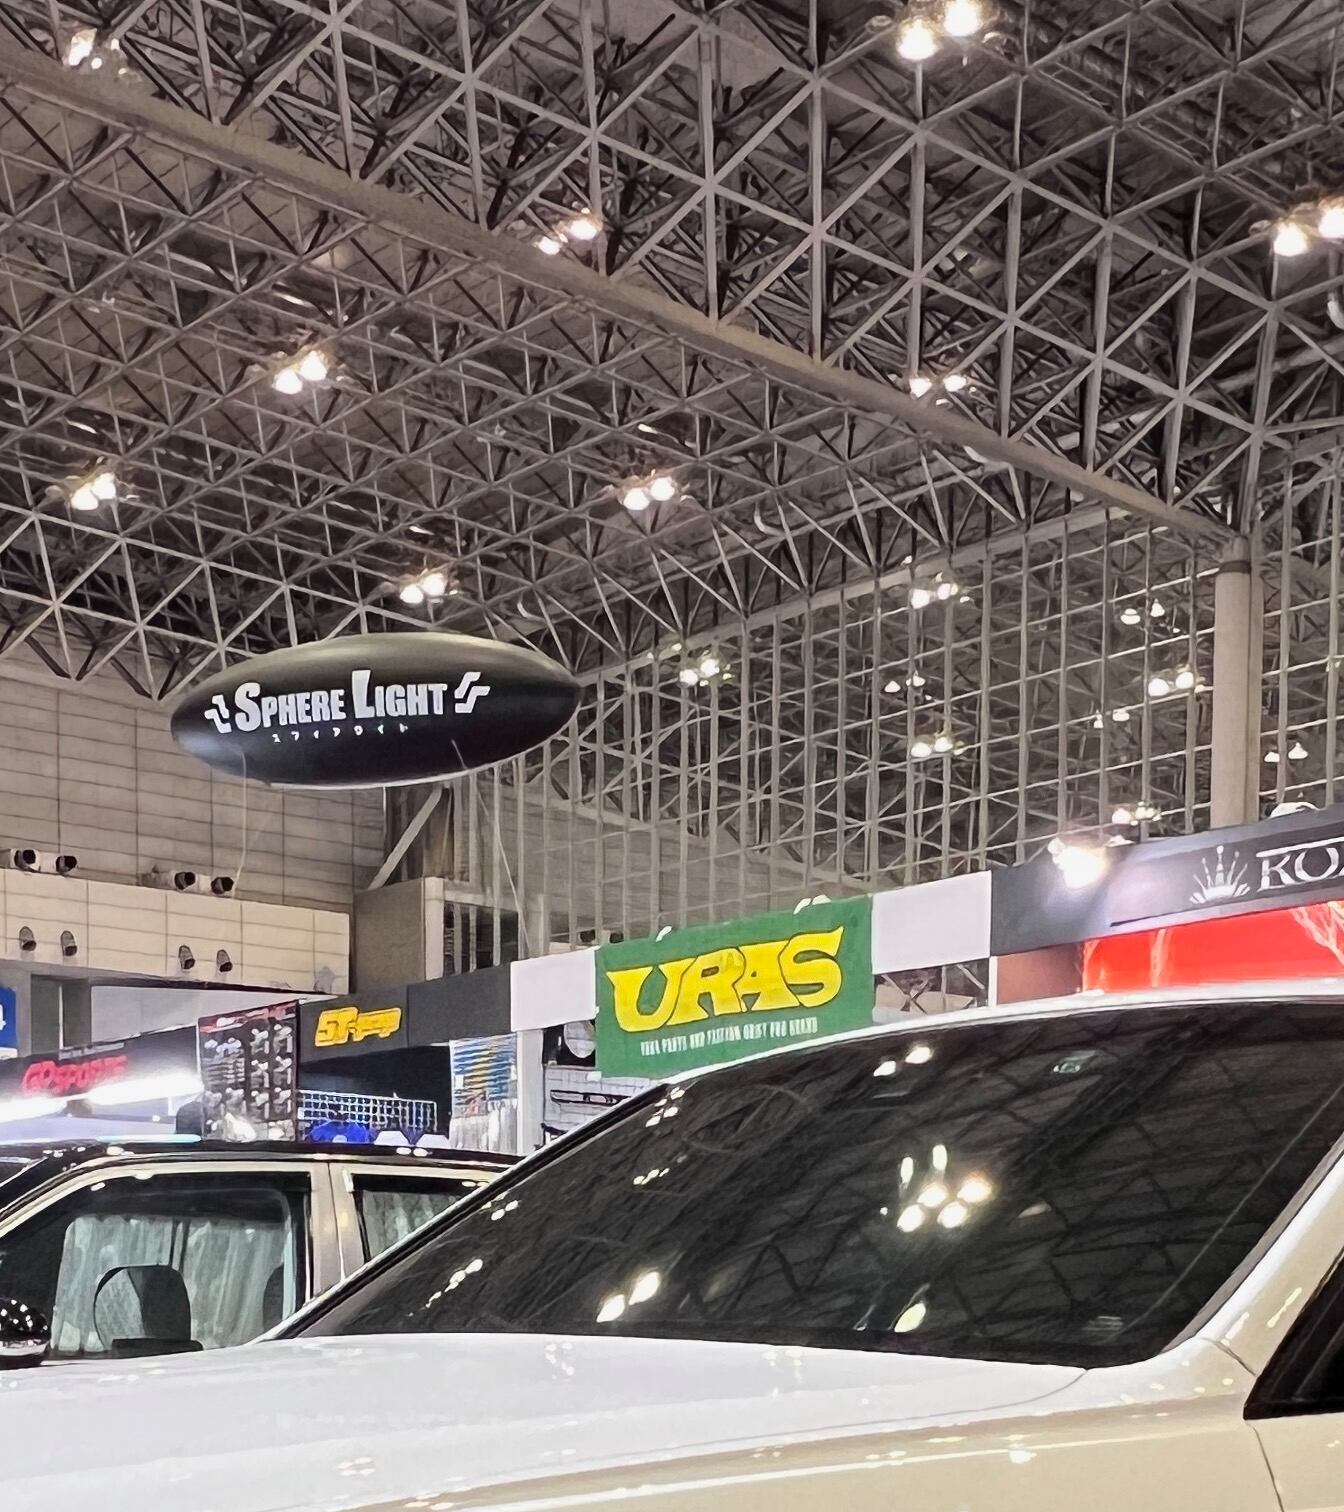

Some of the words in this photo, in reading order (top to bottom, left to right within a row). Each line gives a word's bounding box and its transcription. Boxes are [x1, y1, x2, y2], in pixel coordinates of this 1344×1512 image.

[234, 682, 347, 732] SPHERE
[352, 669, 448, 719] LIGHT
[606, 926, 845, 1033] URAS
